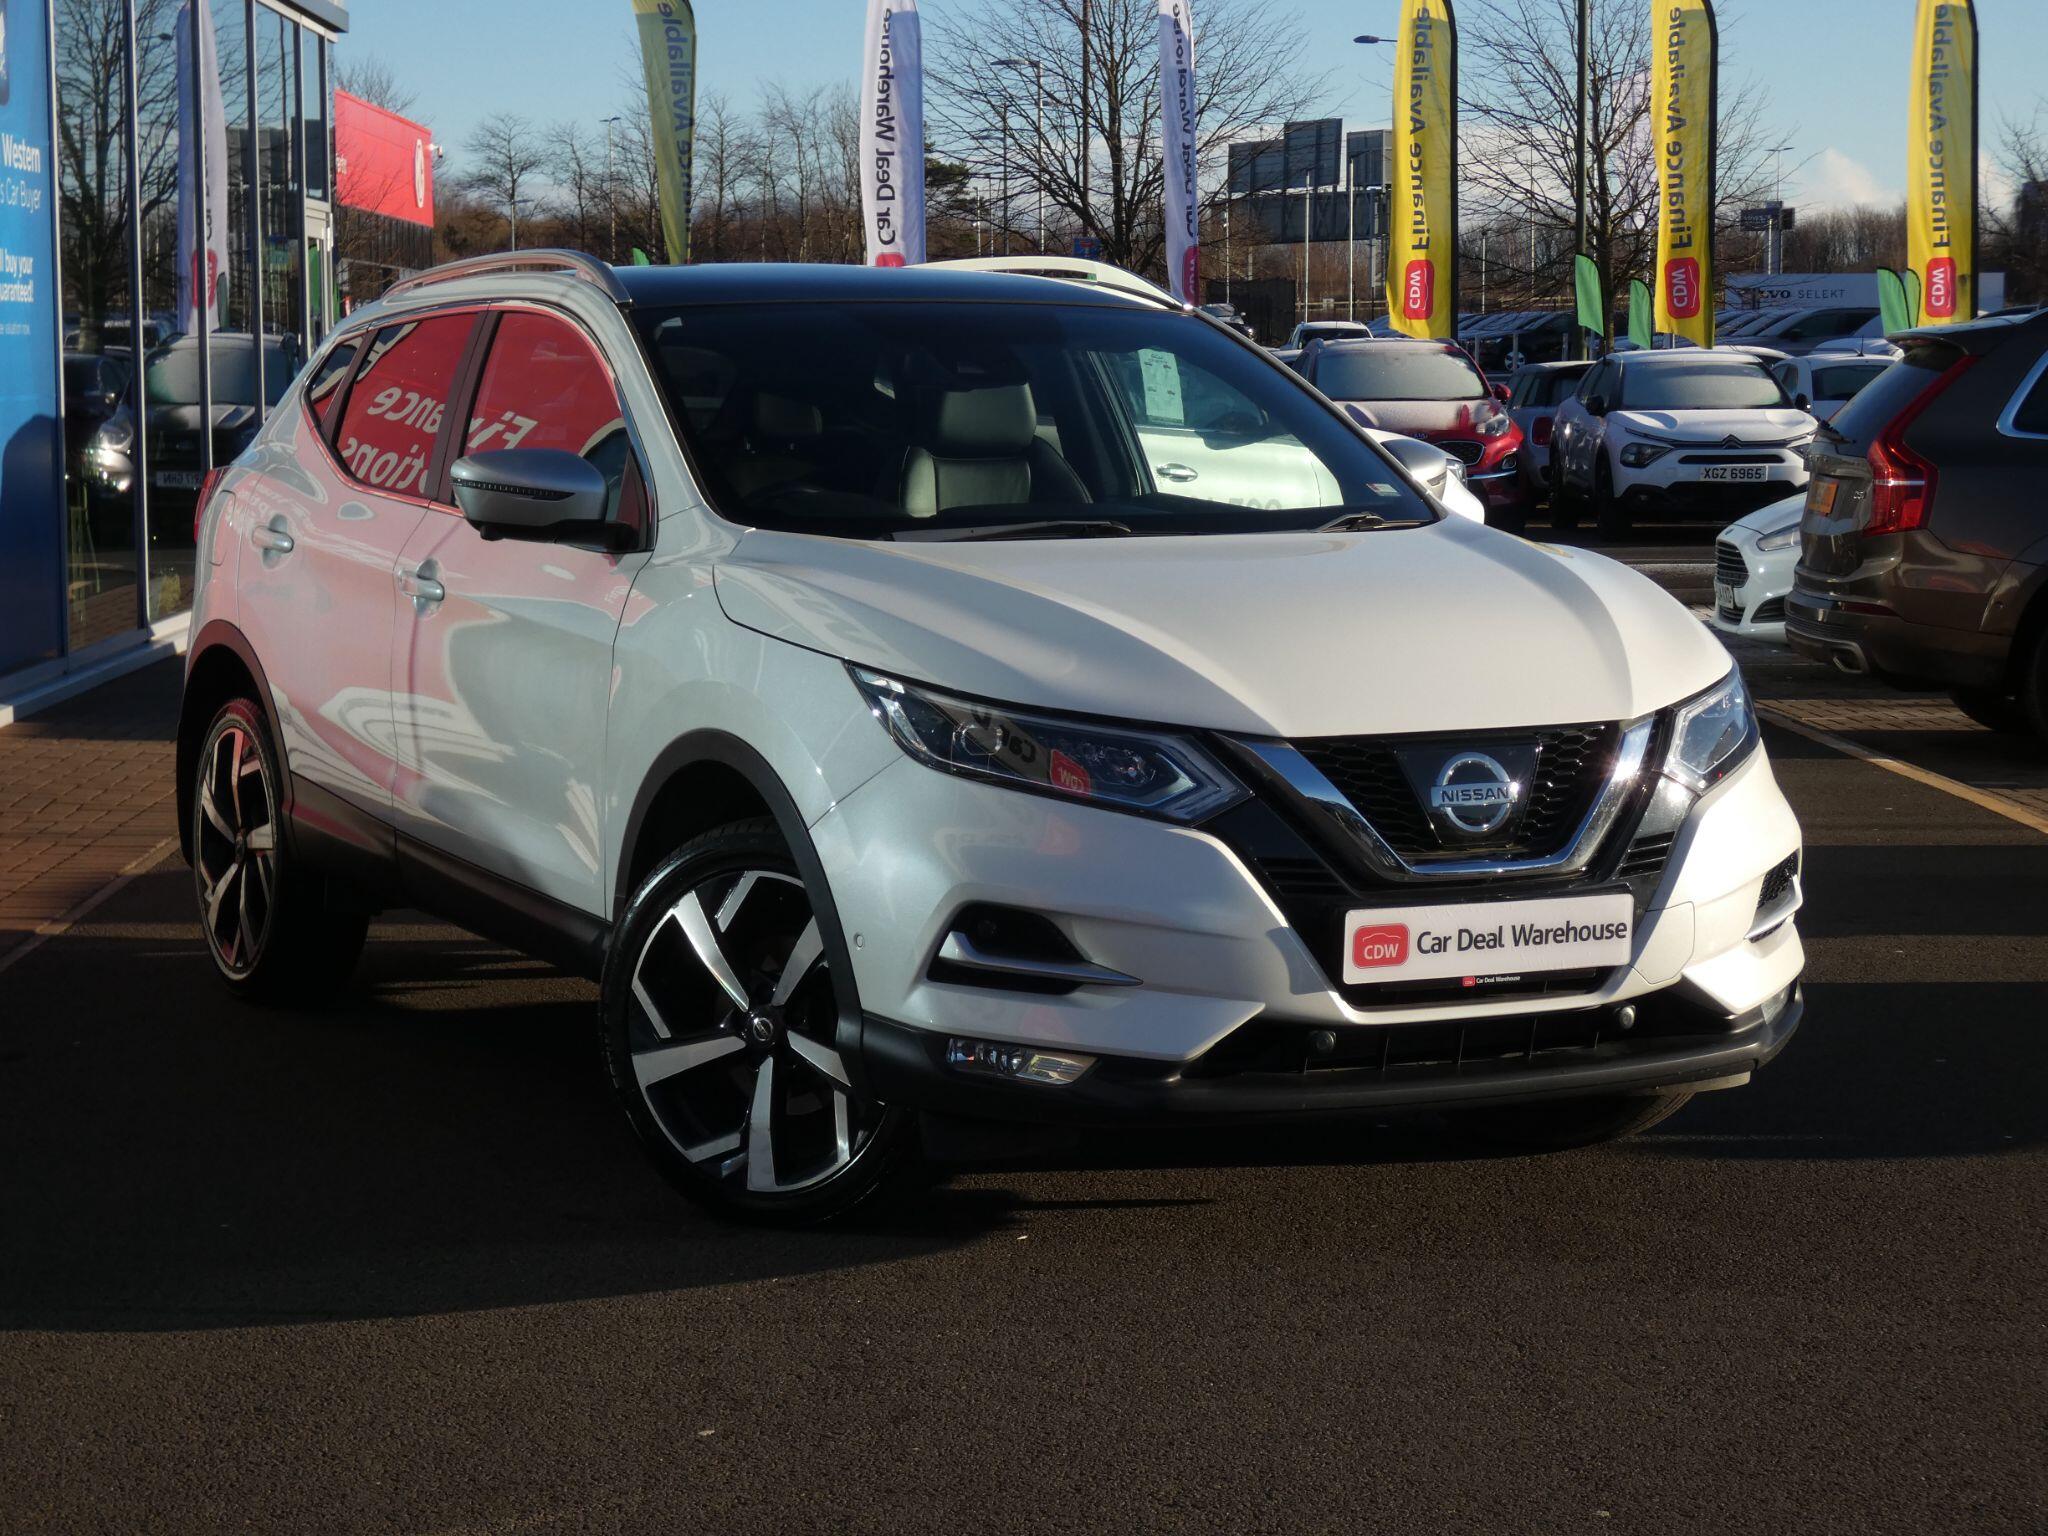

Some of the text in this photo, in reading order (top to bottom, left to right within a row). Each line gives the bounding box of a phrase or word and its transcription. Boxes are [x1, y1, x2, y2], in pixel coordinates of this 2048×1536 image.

[1, 132, 41, 174] Western
[6, 177, 19, 205] Car
[20, 180, 41, 214] Buyer
[5, 248, 17, 278] buy
[18, 256, 33, 278] your
[1797, 289, 1846, 299] SELEKT
[1704, 467, 1762, 479] XGZ 6965
[1441, 787, 1510, 802] NISSAN
[1416, 920, 1629, 954] Car Deal Warehouse
[1364, 942, 1399, 960] CDW
